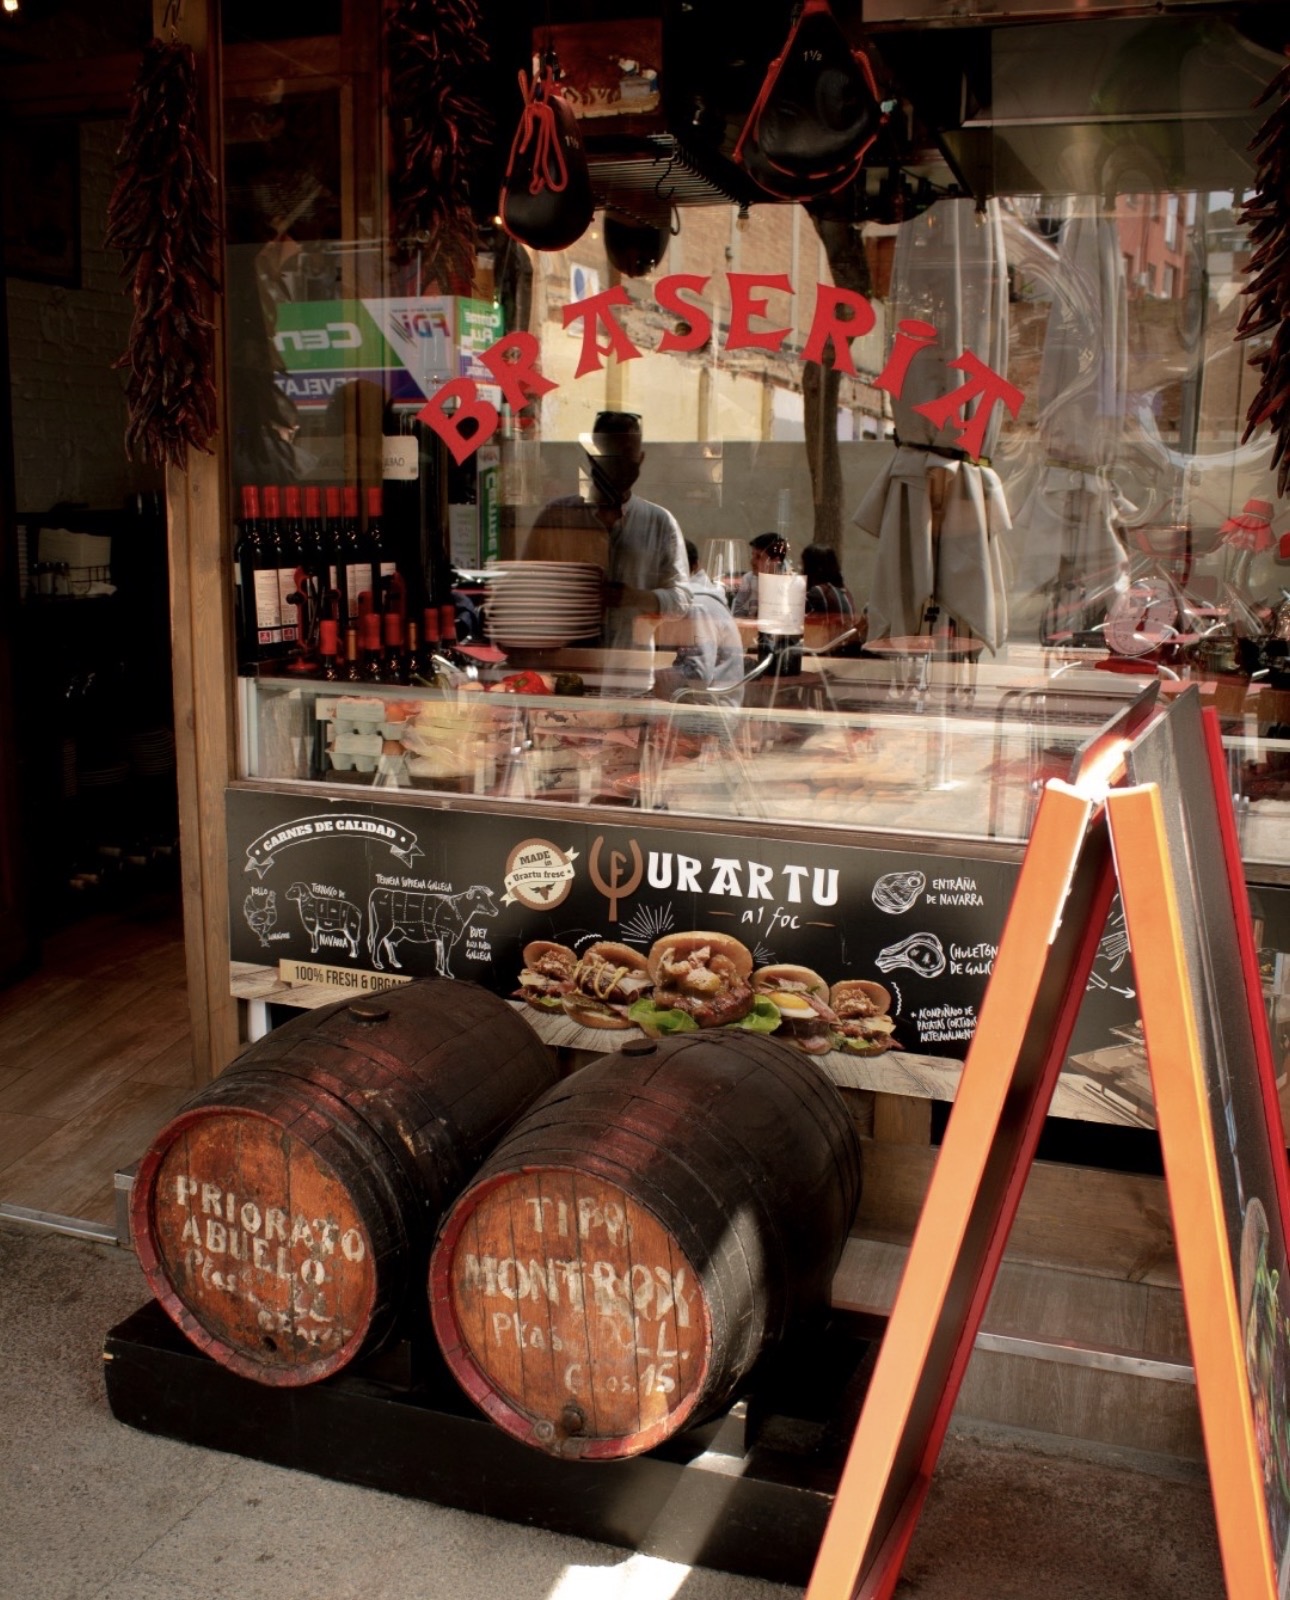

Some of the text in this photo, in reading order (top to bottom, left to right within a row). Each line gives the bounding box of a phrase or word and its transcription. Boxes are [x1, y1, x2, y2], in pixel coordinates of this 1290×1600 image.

[263, 820, 396, 851] CARNES DE CALIDAD
[519, 850, 551, 865] MADE
[544, 859, 553, 867] in
[512, 869, 565, 882] Urartu fresc
[647, 851, 840, 907] URARTU
[932, 877, 977, 891] ENTRAÑA
[926, 893, 984, 906] DE NAVARRA
[741, 906, 800, 938] al foc
[295, 965, 324, 983] 100%
[326, 970, 358, 989] FRESH
[361, 974, 368, 989] &
[949, 960, 963, 975] DE
[176, 1174, 365, 1263] PRIORATO
[181, 1215, 326, 1285] ABUELO
